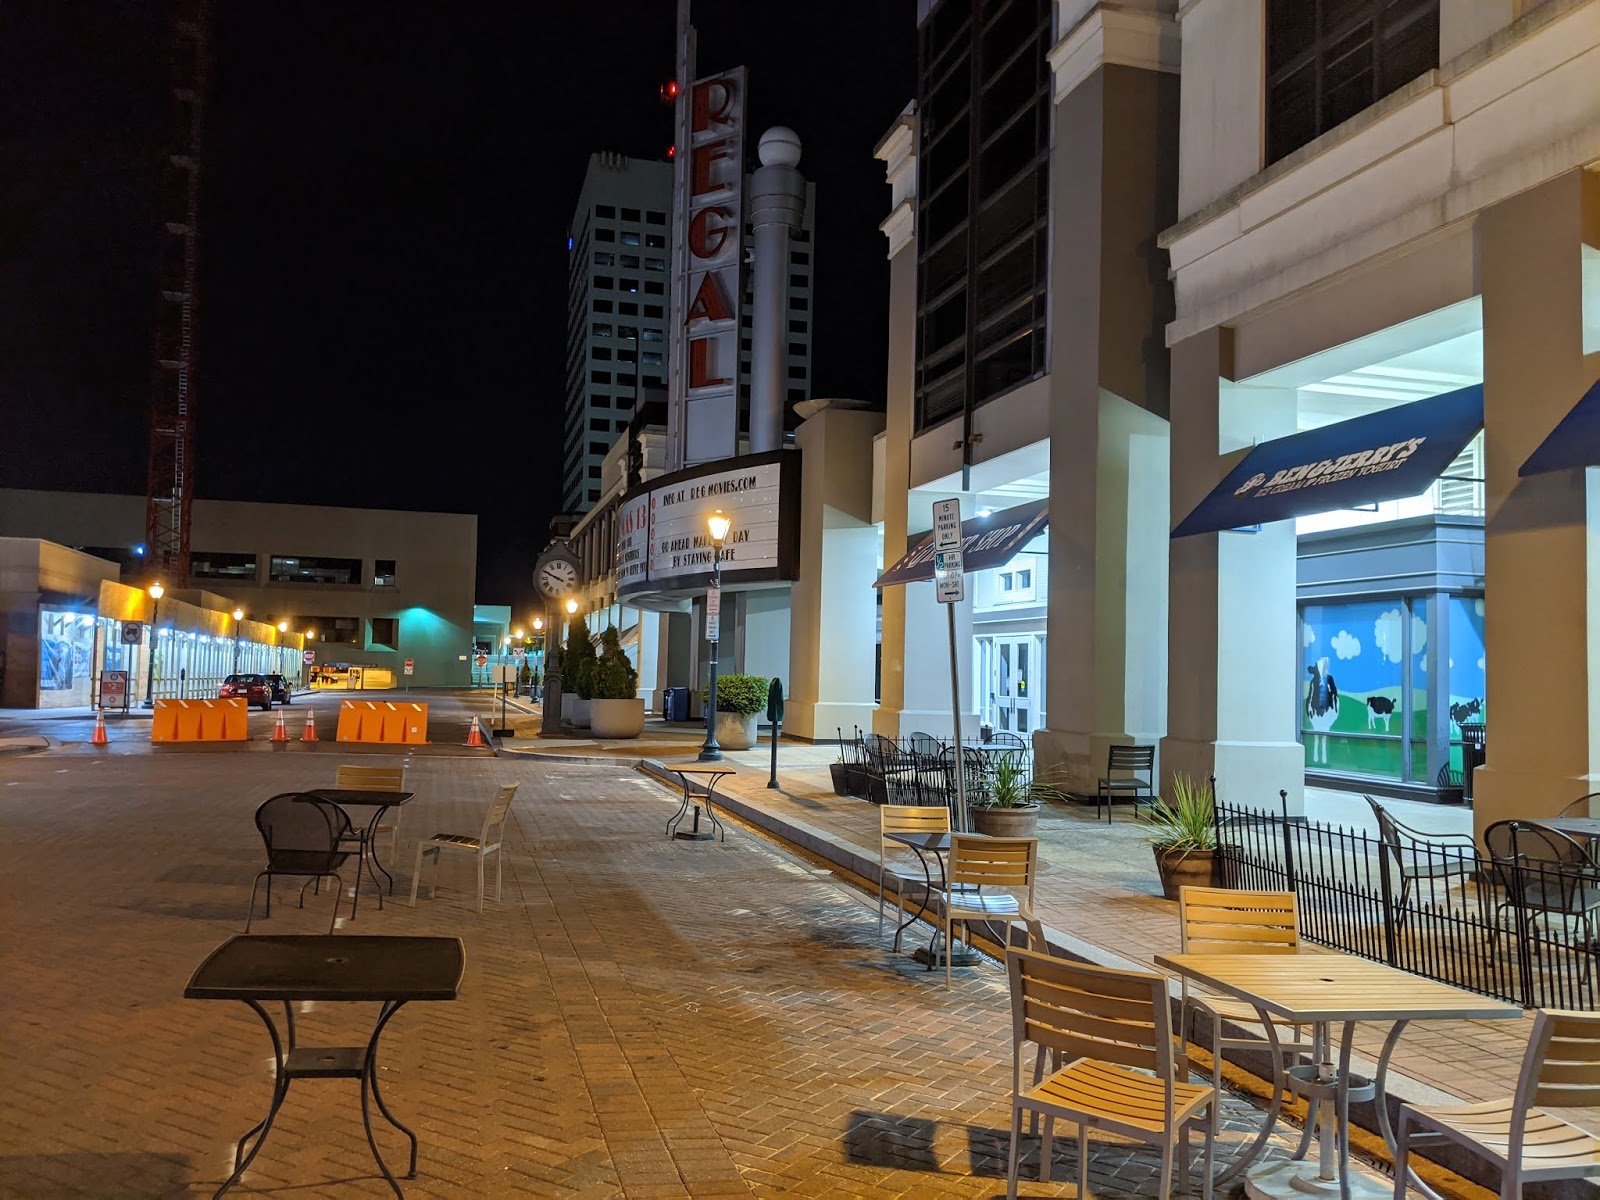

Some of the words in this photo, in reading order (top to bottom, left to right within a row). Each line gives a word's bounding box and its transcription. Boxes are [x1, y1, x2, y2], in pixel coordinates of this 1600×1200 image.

[684, 78, 736, 388] REGAL
[1314, 468, 1358, 485] FROZEN
[1356, 458, 1408, 477] YOGURT
[676, 489, 686, 503] AT
[942, 504, 950, 513] 15
[636, 504, 647, 530] 13
[938, 512, 955, 522] MINUTE
[937, 521, 957, 532] PARKING
[661, 541, 670, 554] GO
[670, 537, 690, 553] AHEAD
[733, 529, 750, 543] DAY
[941, 532, 954, 541] ONLY
[672, 553, 680, 567] BY
[683, 550, 712, 567] STAYING
[948, 553, 956, 562] HR
[944, 560, 961, 570] PARKING
[939, 580, 960, 590] MON-SAT
